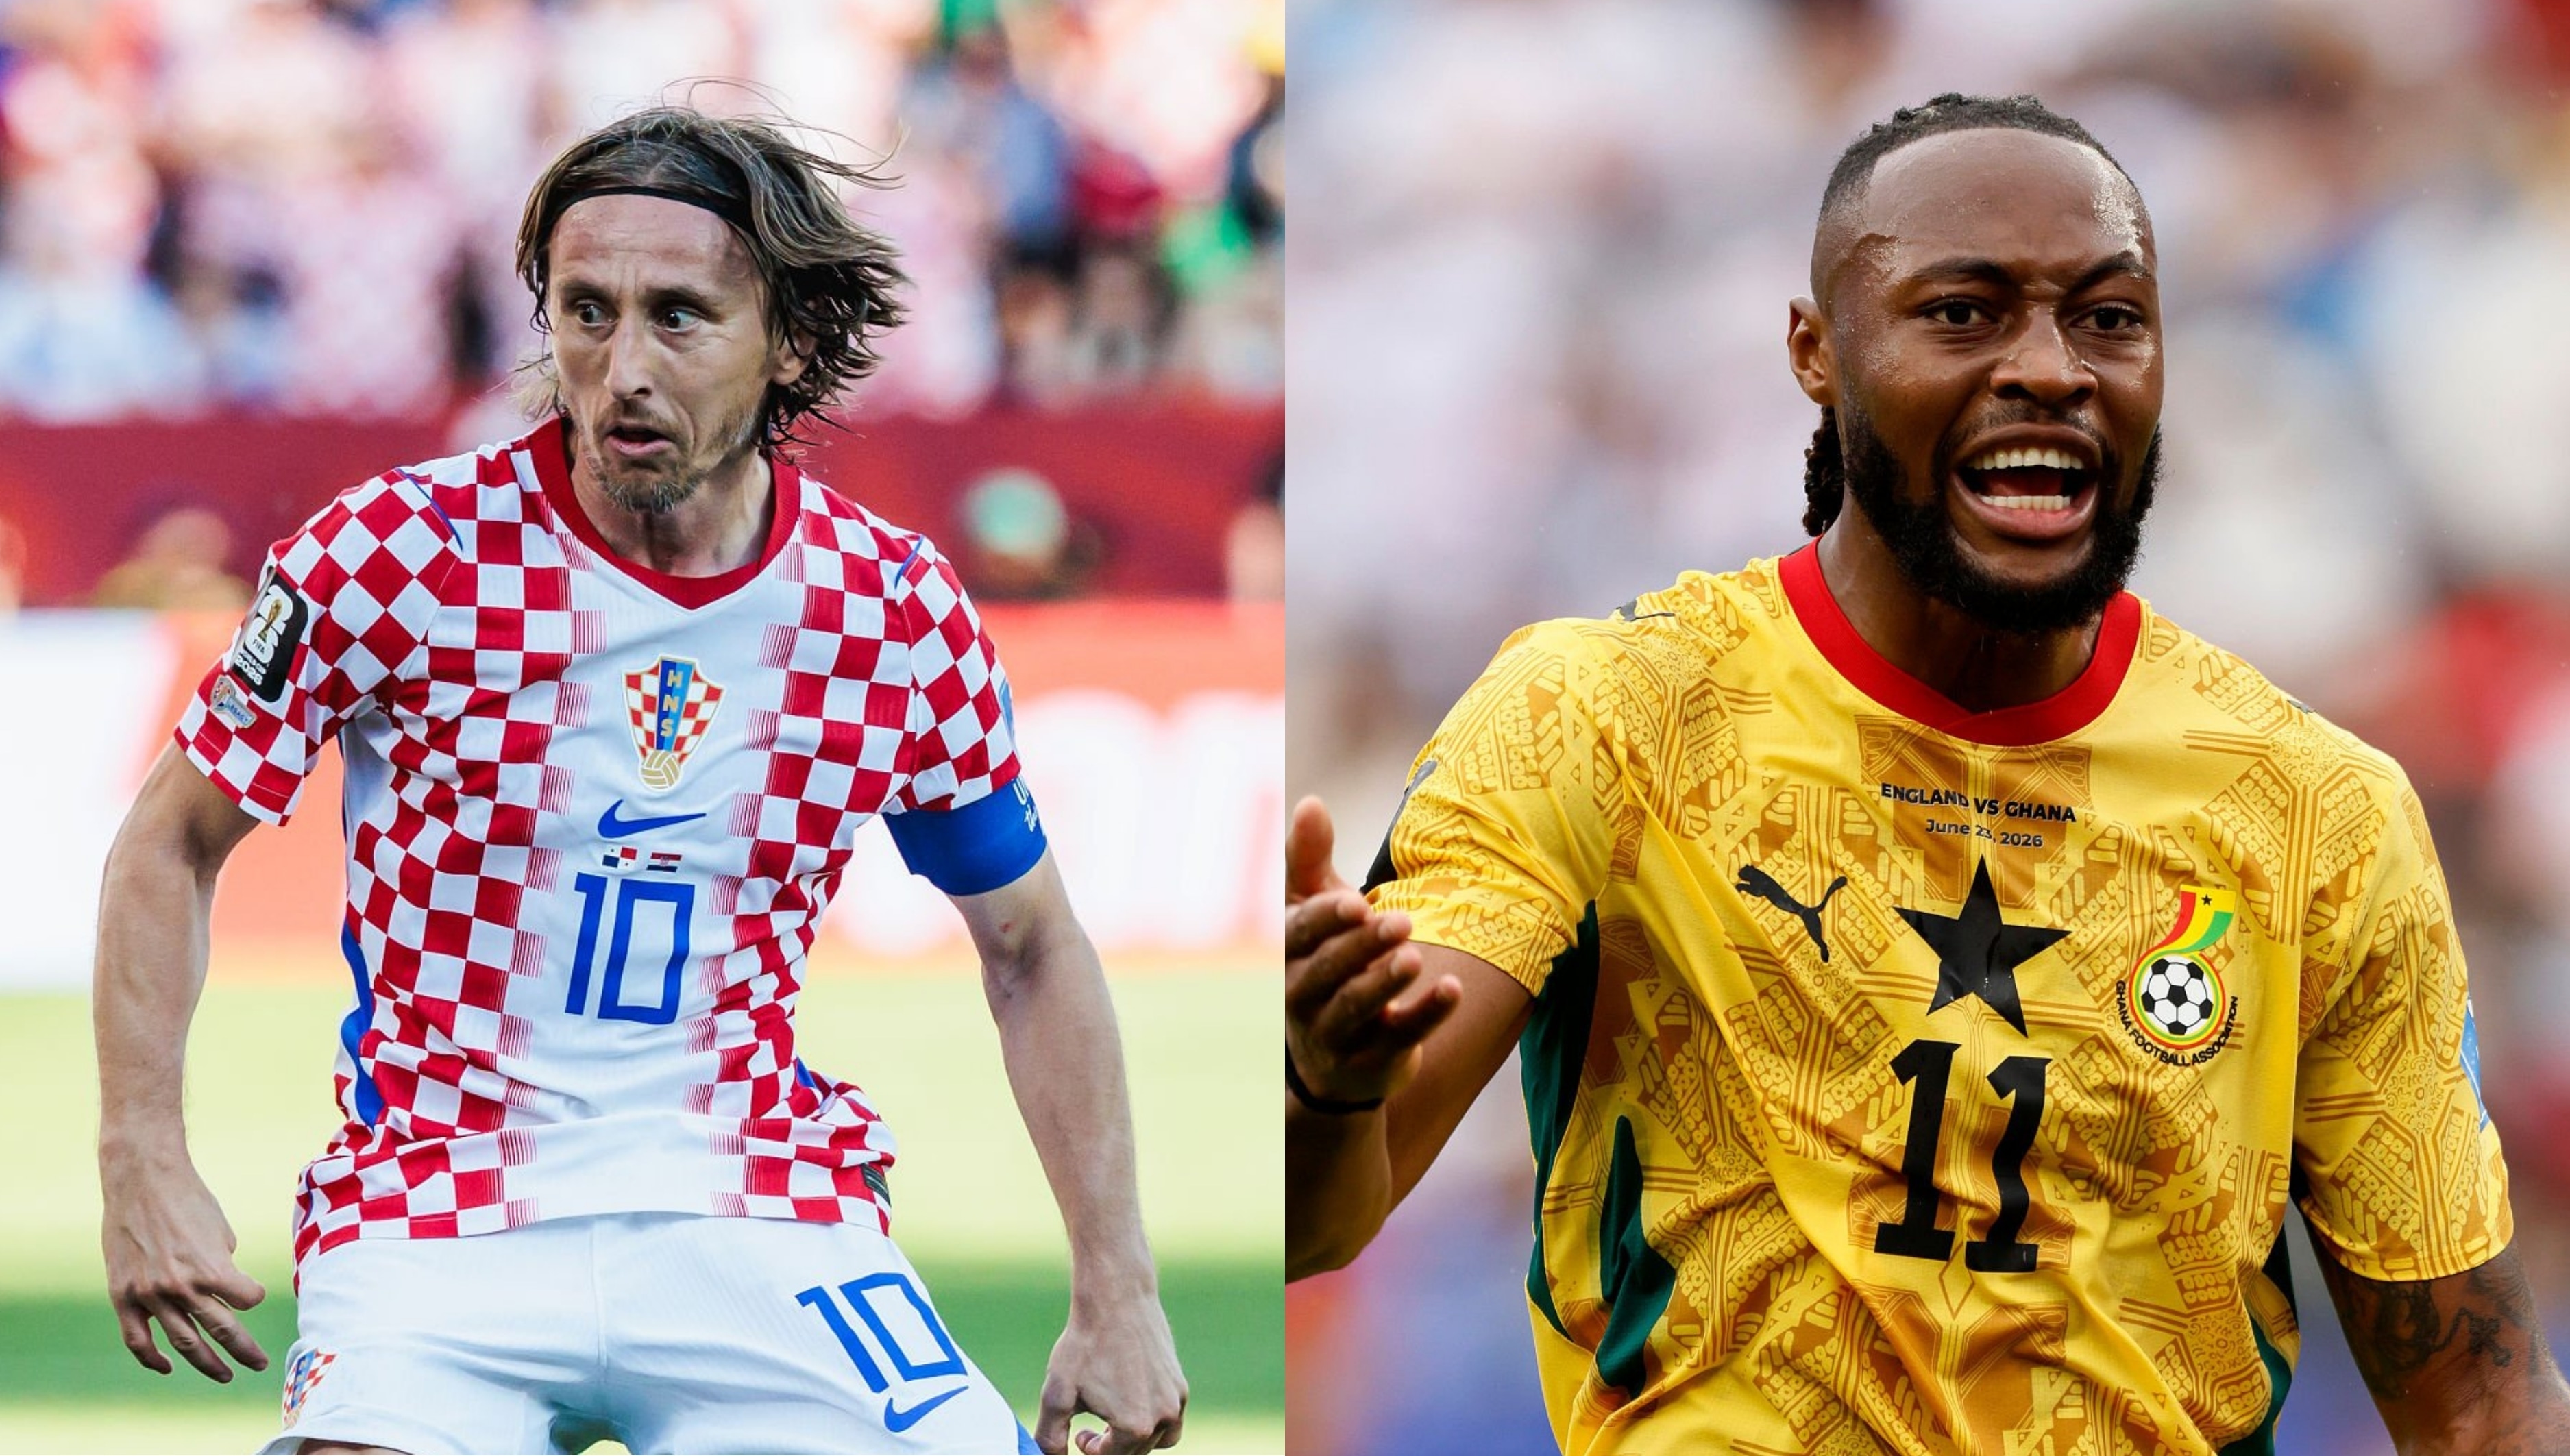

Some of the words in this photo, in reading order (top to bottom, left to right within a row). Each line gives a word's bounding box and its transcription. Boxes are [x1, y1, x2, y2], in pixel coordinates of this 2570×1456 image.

[660, 669, 683, 737] HNS
[1881, 782, 1969, 807] ENGLAND
[1974, 798, 1999, 815] VS
[2005, 801, 2077, 822] GHANA
[1926, 819, 1970, 835] June
[1974, 825, 1996, 843] 23,
[2000, 832, 2044, 848] 2026
[565, 872, 695, 1025] 10
[2116, 980, 2132, 1030] GHANA
[2129, 1028, 2191, 1067] FOOTBALL
[2191, 996, 2238, 1065] ASSOCIATION
[1874, 1039, 2053, 1273] 11
[794, 1272, 968, 1394] 10
